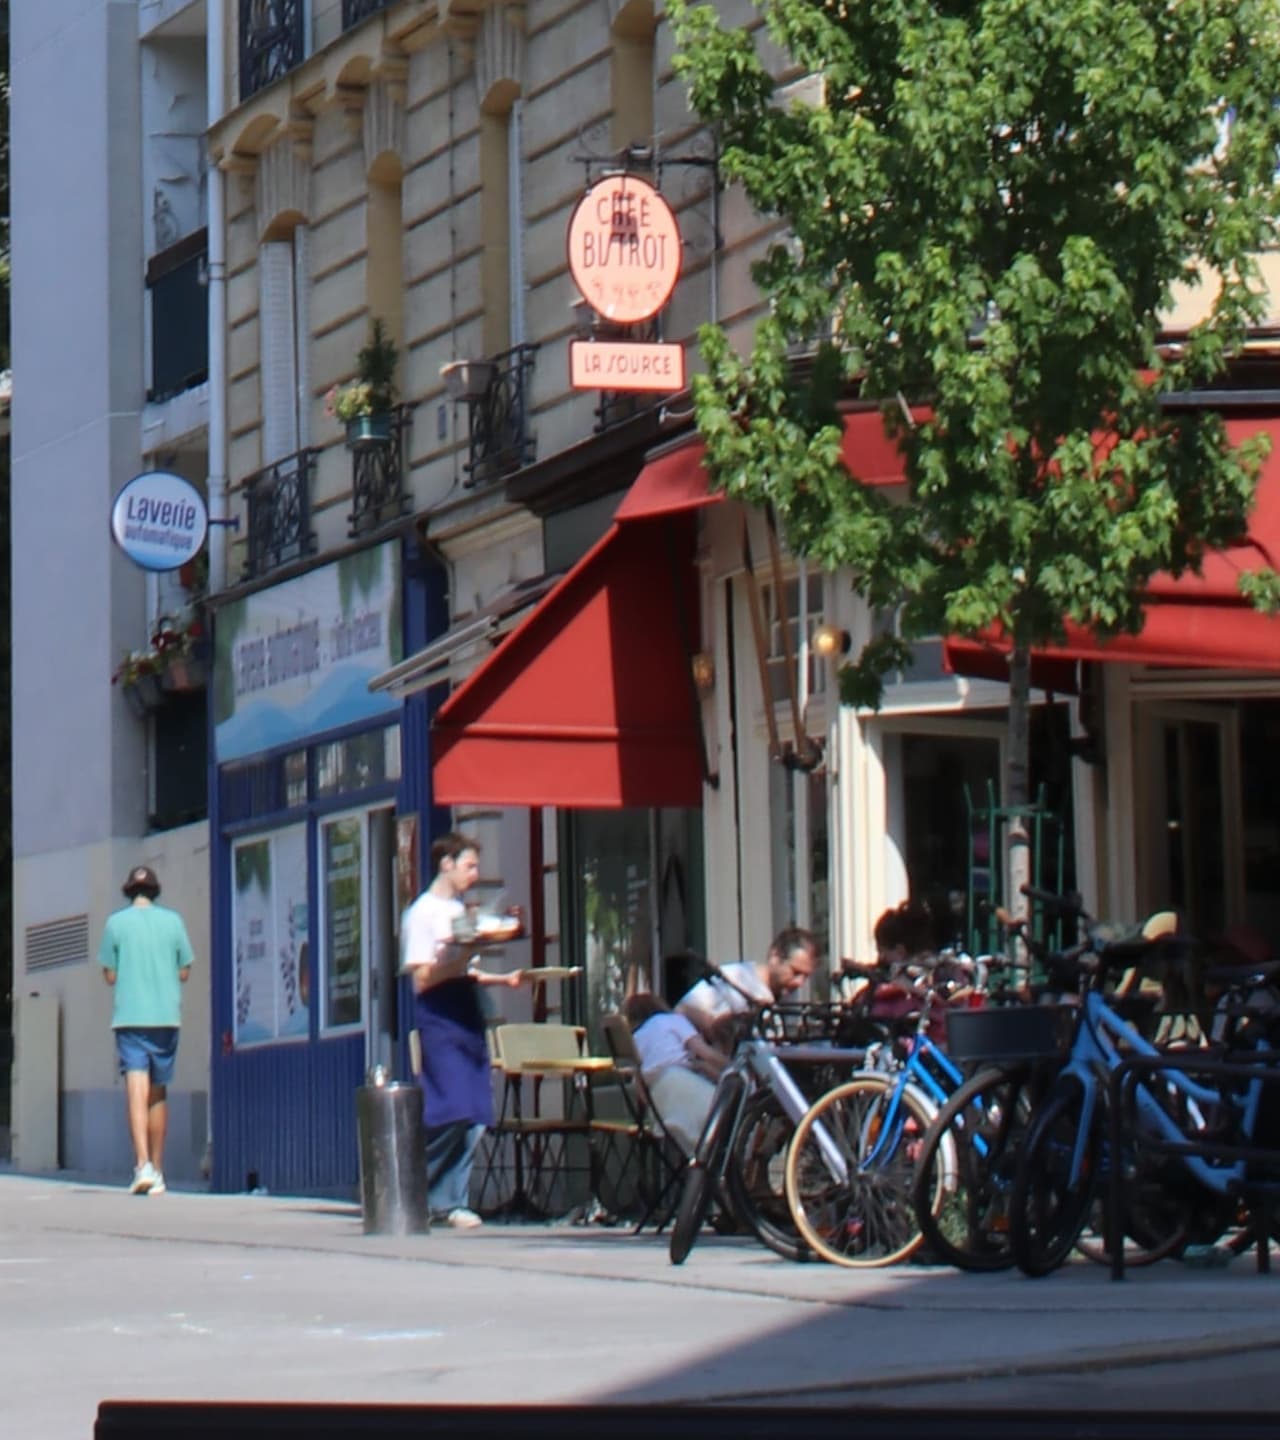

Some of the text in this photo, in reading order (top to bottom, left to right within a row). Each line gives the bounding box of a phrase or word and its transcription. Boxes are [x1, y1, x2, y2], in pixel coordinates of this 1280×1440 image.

[583, 231, 666, 270] BISTROT
[584, 354, 671, 375] LA SOURCE
[127, 496, 196, 531] Laverie
